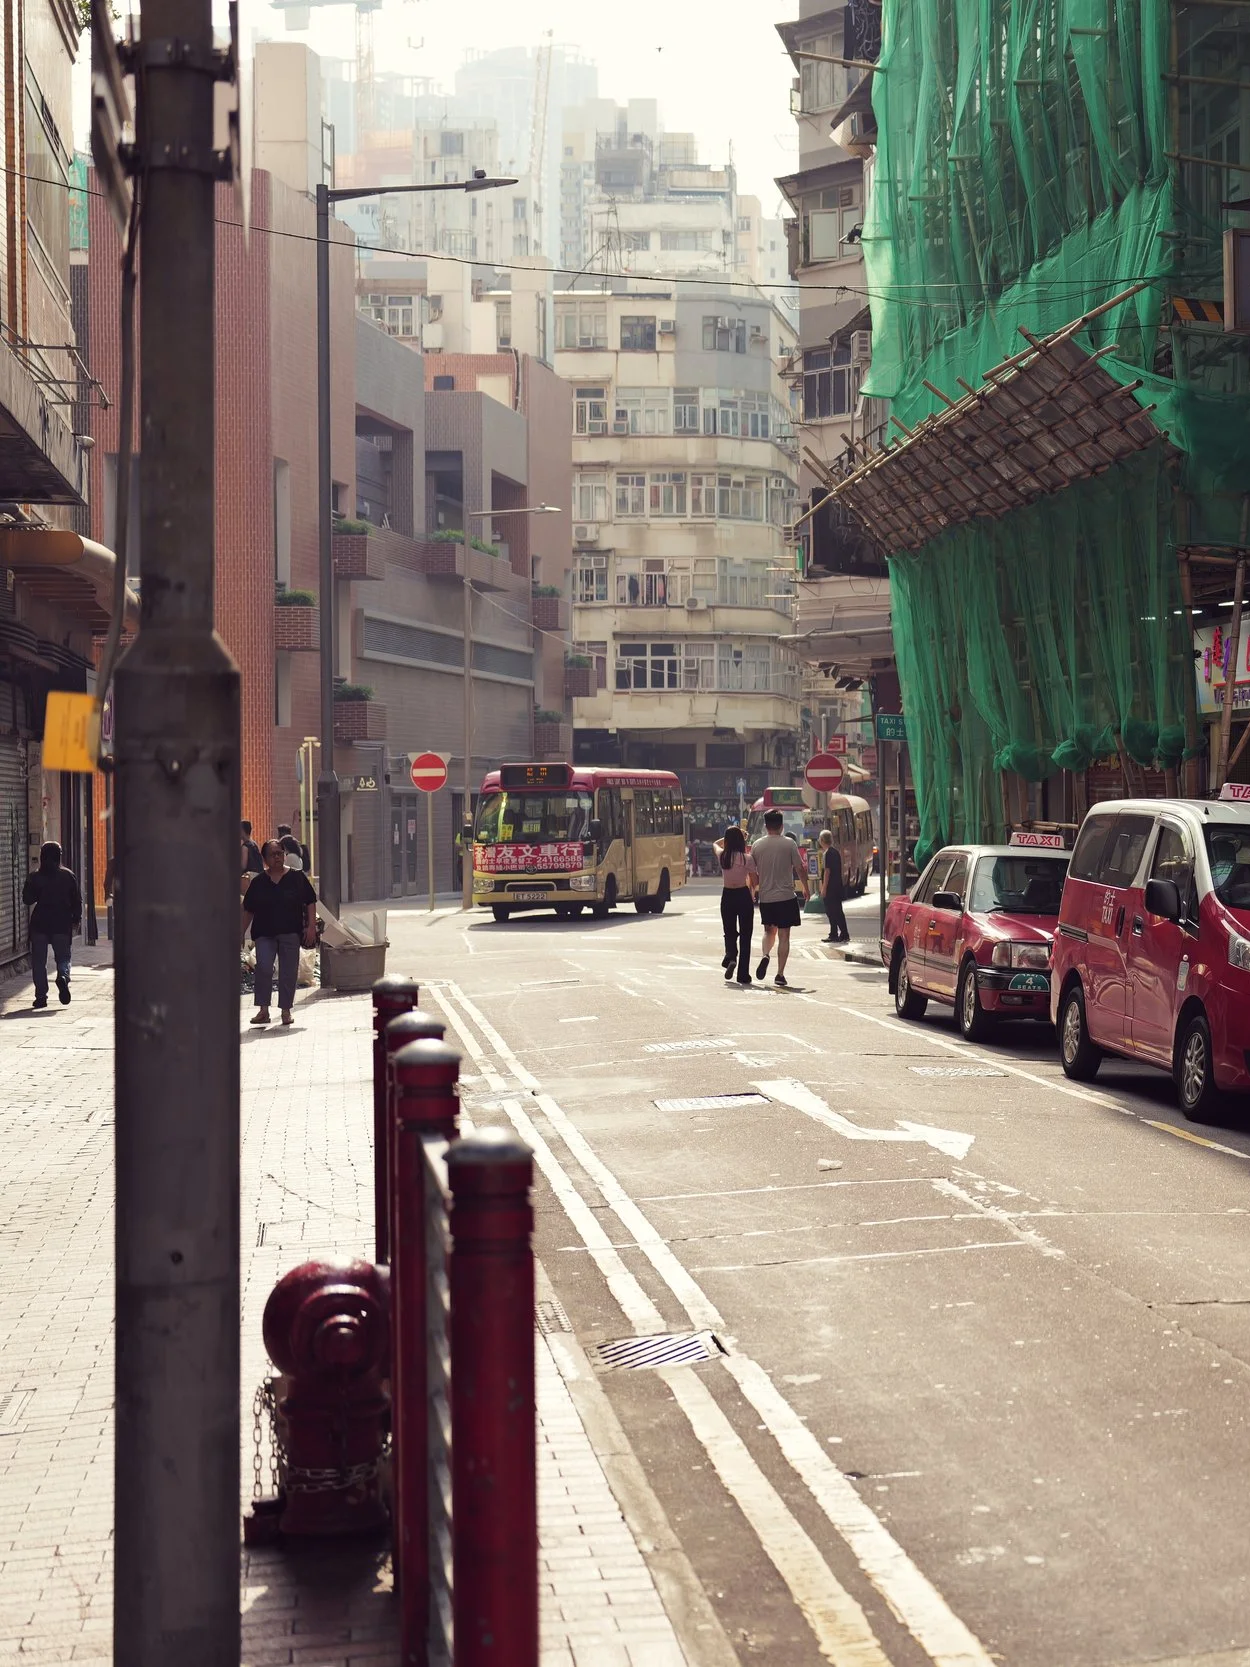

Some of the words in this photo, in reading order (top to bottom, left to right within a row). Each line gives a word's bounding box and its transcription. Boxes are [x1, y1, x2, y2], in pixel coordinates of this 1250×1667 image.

[880, 717, 896, 725] TAXI
[886, 727, 904, 737] 的士
[1016, 833, 1061, 847] TAXI
[1103, 889, 1116, 906] 的士
[1025, 977, 1034, 985] 4
